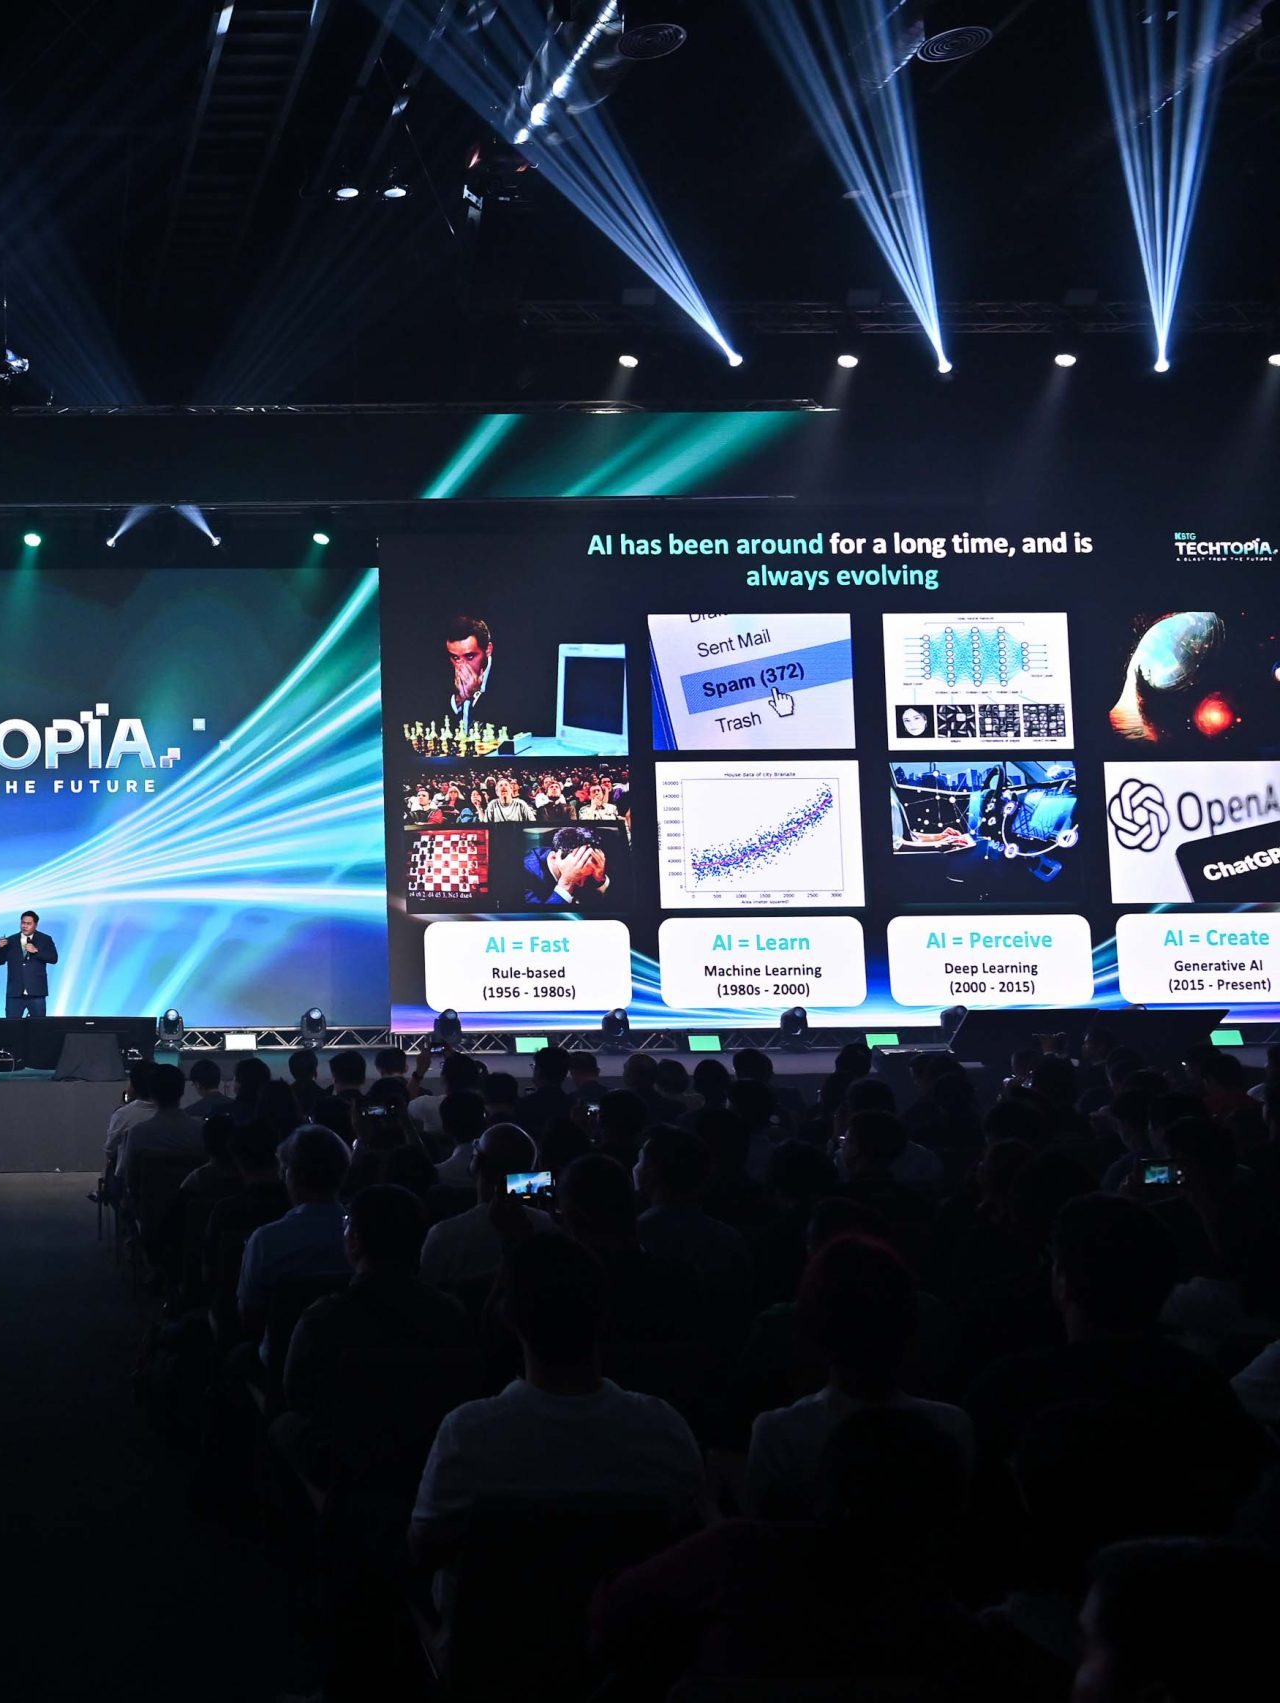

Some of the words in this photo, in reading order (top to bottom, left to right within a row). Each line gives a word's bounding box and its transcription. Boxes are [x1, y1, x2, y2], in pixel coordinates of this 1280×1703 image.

[588, 535, 612, 555] AI
[621, 534, 661, 555] has
[669, 534, 728, 554] been
[737, 533, 823, 554] around
[829, 533, 866, 554] for
[873, 538, 886, 553] a
[894, 532, 946, 558] long
[952, 532, 1015, 557] time,
[1022, 532, 1067, 553] and
[1074, 532, 1093, 553] is
[1175, 538, 1272, 555] TECHTOPIA
[747, 565, 829, 590] always
[837, 564, 938, 589] evolving
[698, 638, 735, 657] Sent
[738, 629, 770, 648] Mail
[702, 674, 756, 699] Spam
[760, 661, 805, 690] (372)
[715, 711, 762, 734] Trash
[53, 779, 154, 793] FUTURE
[486, 937, 505, 953] AI
[530, 936, 569, 952] Fast
[713, 935, 732, 950] AI
[757, 935, 810, 950] Learn
[927, 933, 945, 948] AI
[970, 931, 1052, 948] Perceive
[1164, 930, 1183, 946] AI
[1207, 930, 1269, 946] Create
[493, 967, 565, 978] Rule-based
[705, 965, 760, 976] Machine
[766, 964, 822, 978] Learning
[945, 963, 978, 976] Deep
[983, 962, 1038, 976] Learning
[1175, 960, 1245, 971] Generative
[1250, 960, 1262, 970] AI
[483, 986, 520, 1000] (1956
[534, 985, 575, 999] 1980s)
[718, 984, 760, 998] (1980s
[773, 983, 809, 997] 2000)
[950, 981, 986, 995] (2000
[999, 980, 1034, 994] 2015)
[1169, 979, 1204, 993] (2015
[1218, 978, 1271, 992] Present)
